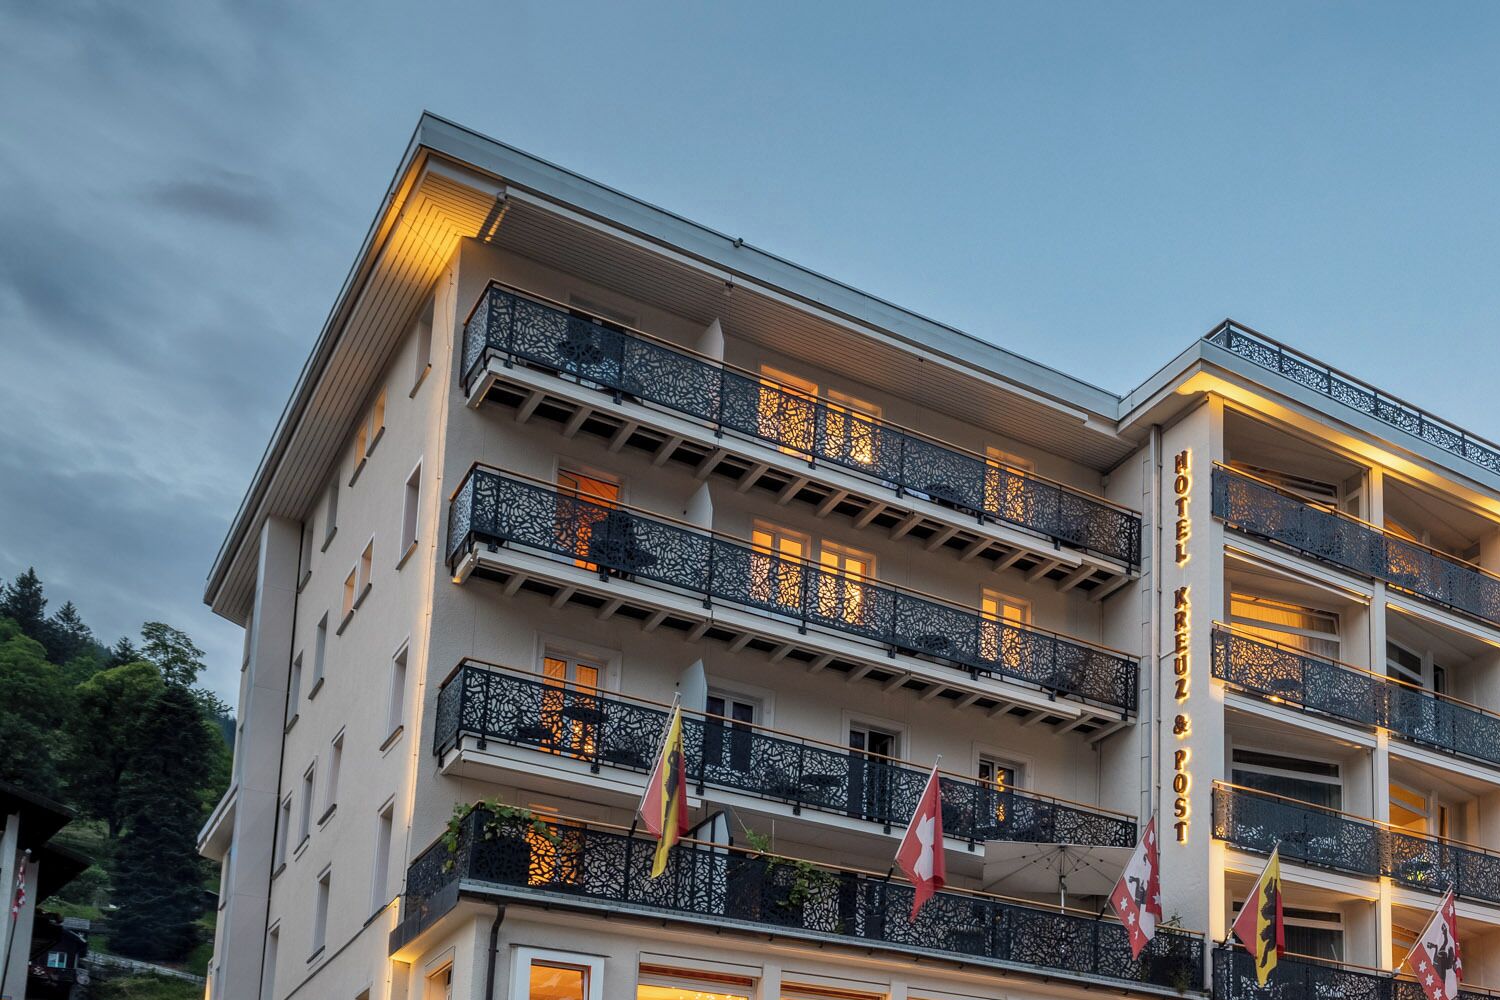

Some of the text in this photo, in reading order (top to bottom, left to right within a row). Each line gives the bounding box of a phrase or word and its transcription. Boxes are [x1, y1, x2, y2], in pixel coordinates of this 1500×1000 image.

[1172, 450, 1190, 843] HOTEL KREUZ & POST
